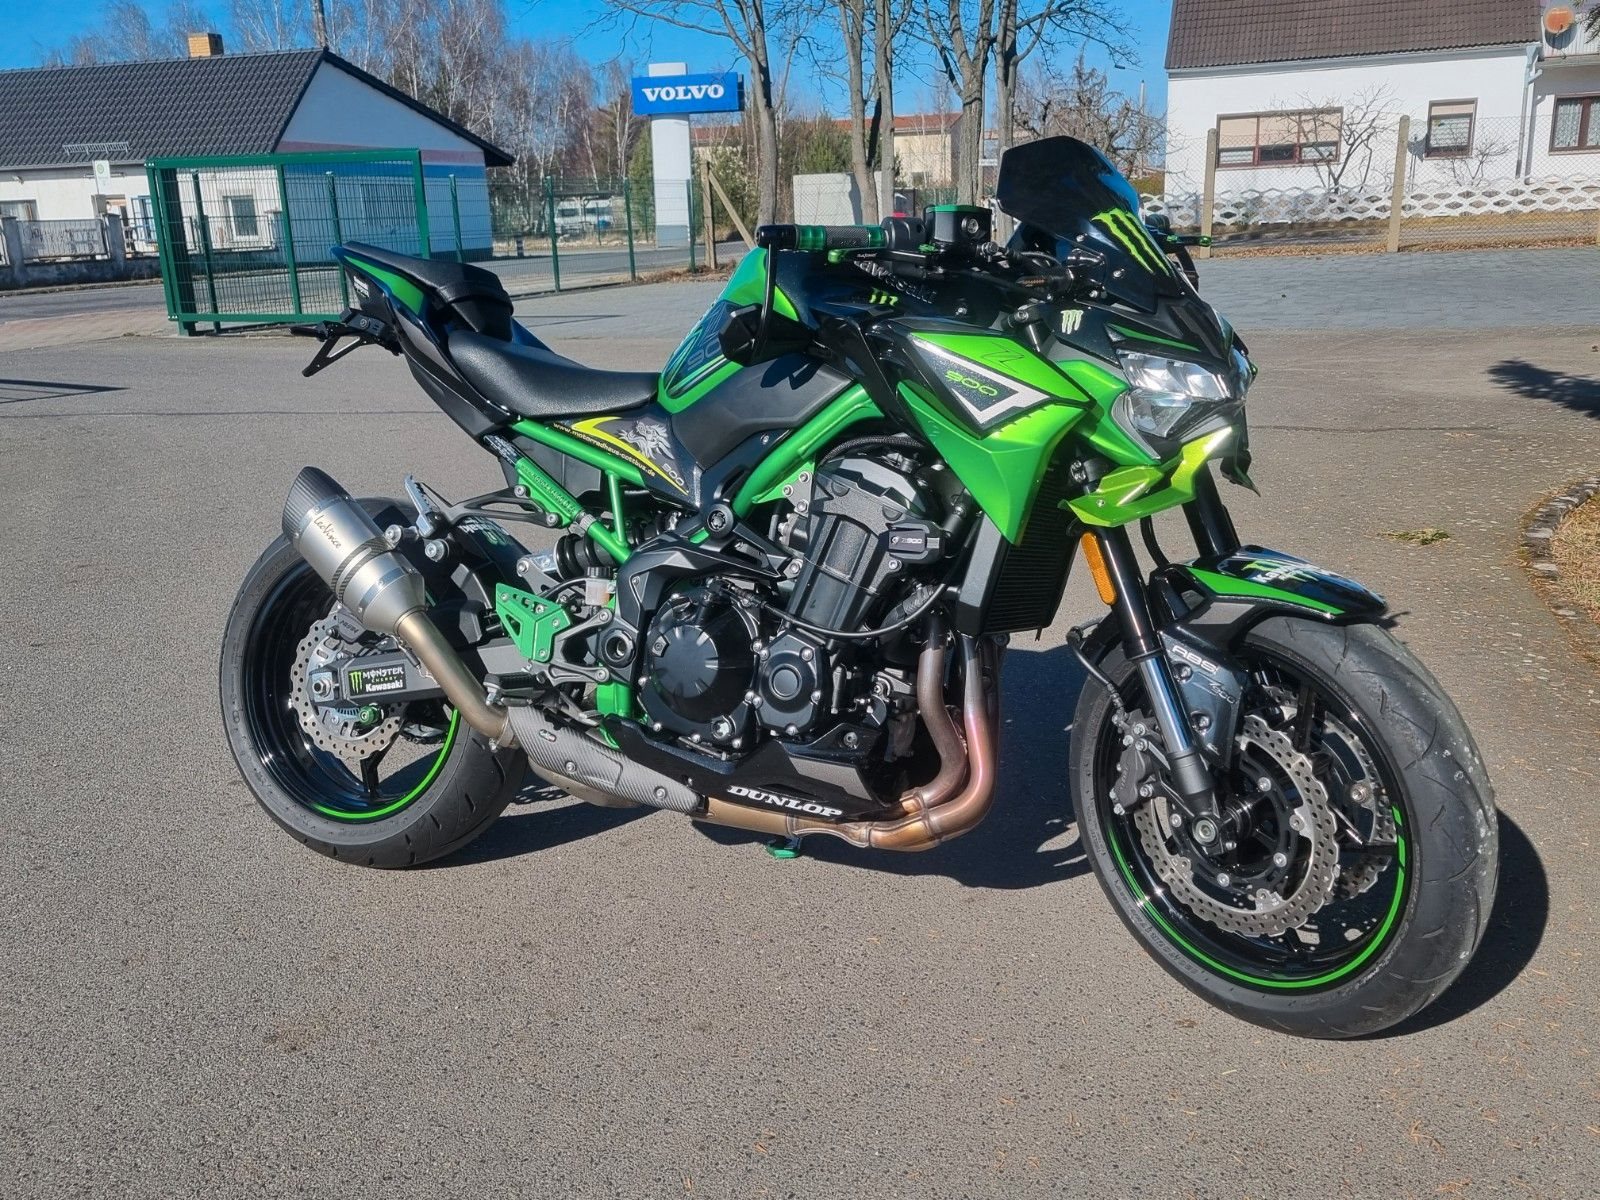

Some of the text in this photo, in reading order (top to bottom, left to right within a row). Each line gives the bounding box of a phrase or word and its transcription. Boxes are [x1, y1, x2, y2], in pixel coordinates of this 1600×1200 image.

[642, 84, 724, 102] VOLVO
[687, 338, 722, 371] 90
[945, 370, 998, 397] 900
[661, 463, 685, 486] 900
[363, 666, 404, 679] MONSTER
[1172, 645, 1218, 675] ABS
[365, 680, 404, 692] Kawasaki
[727, 785, 843, 817] DUNLOP
